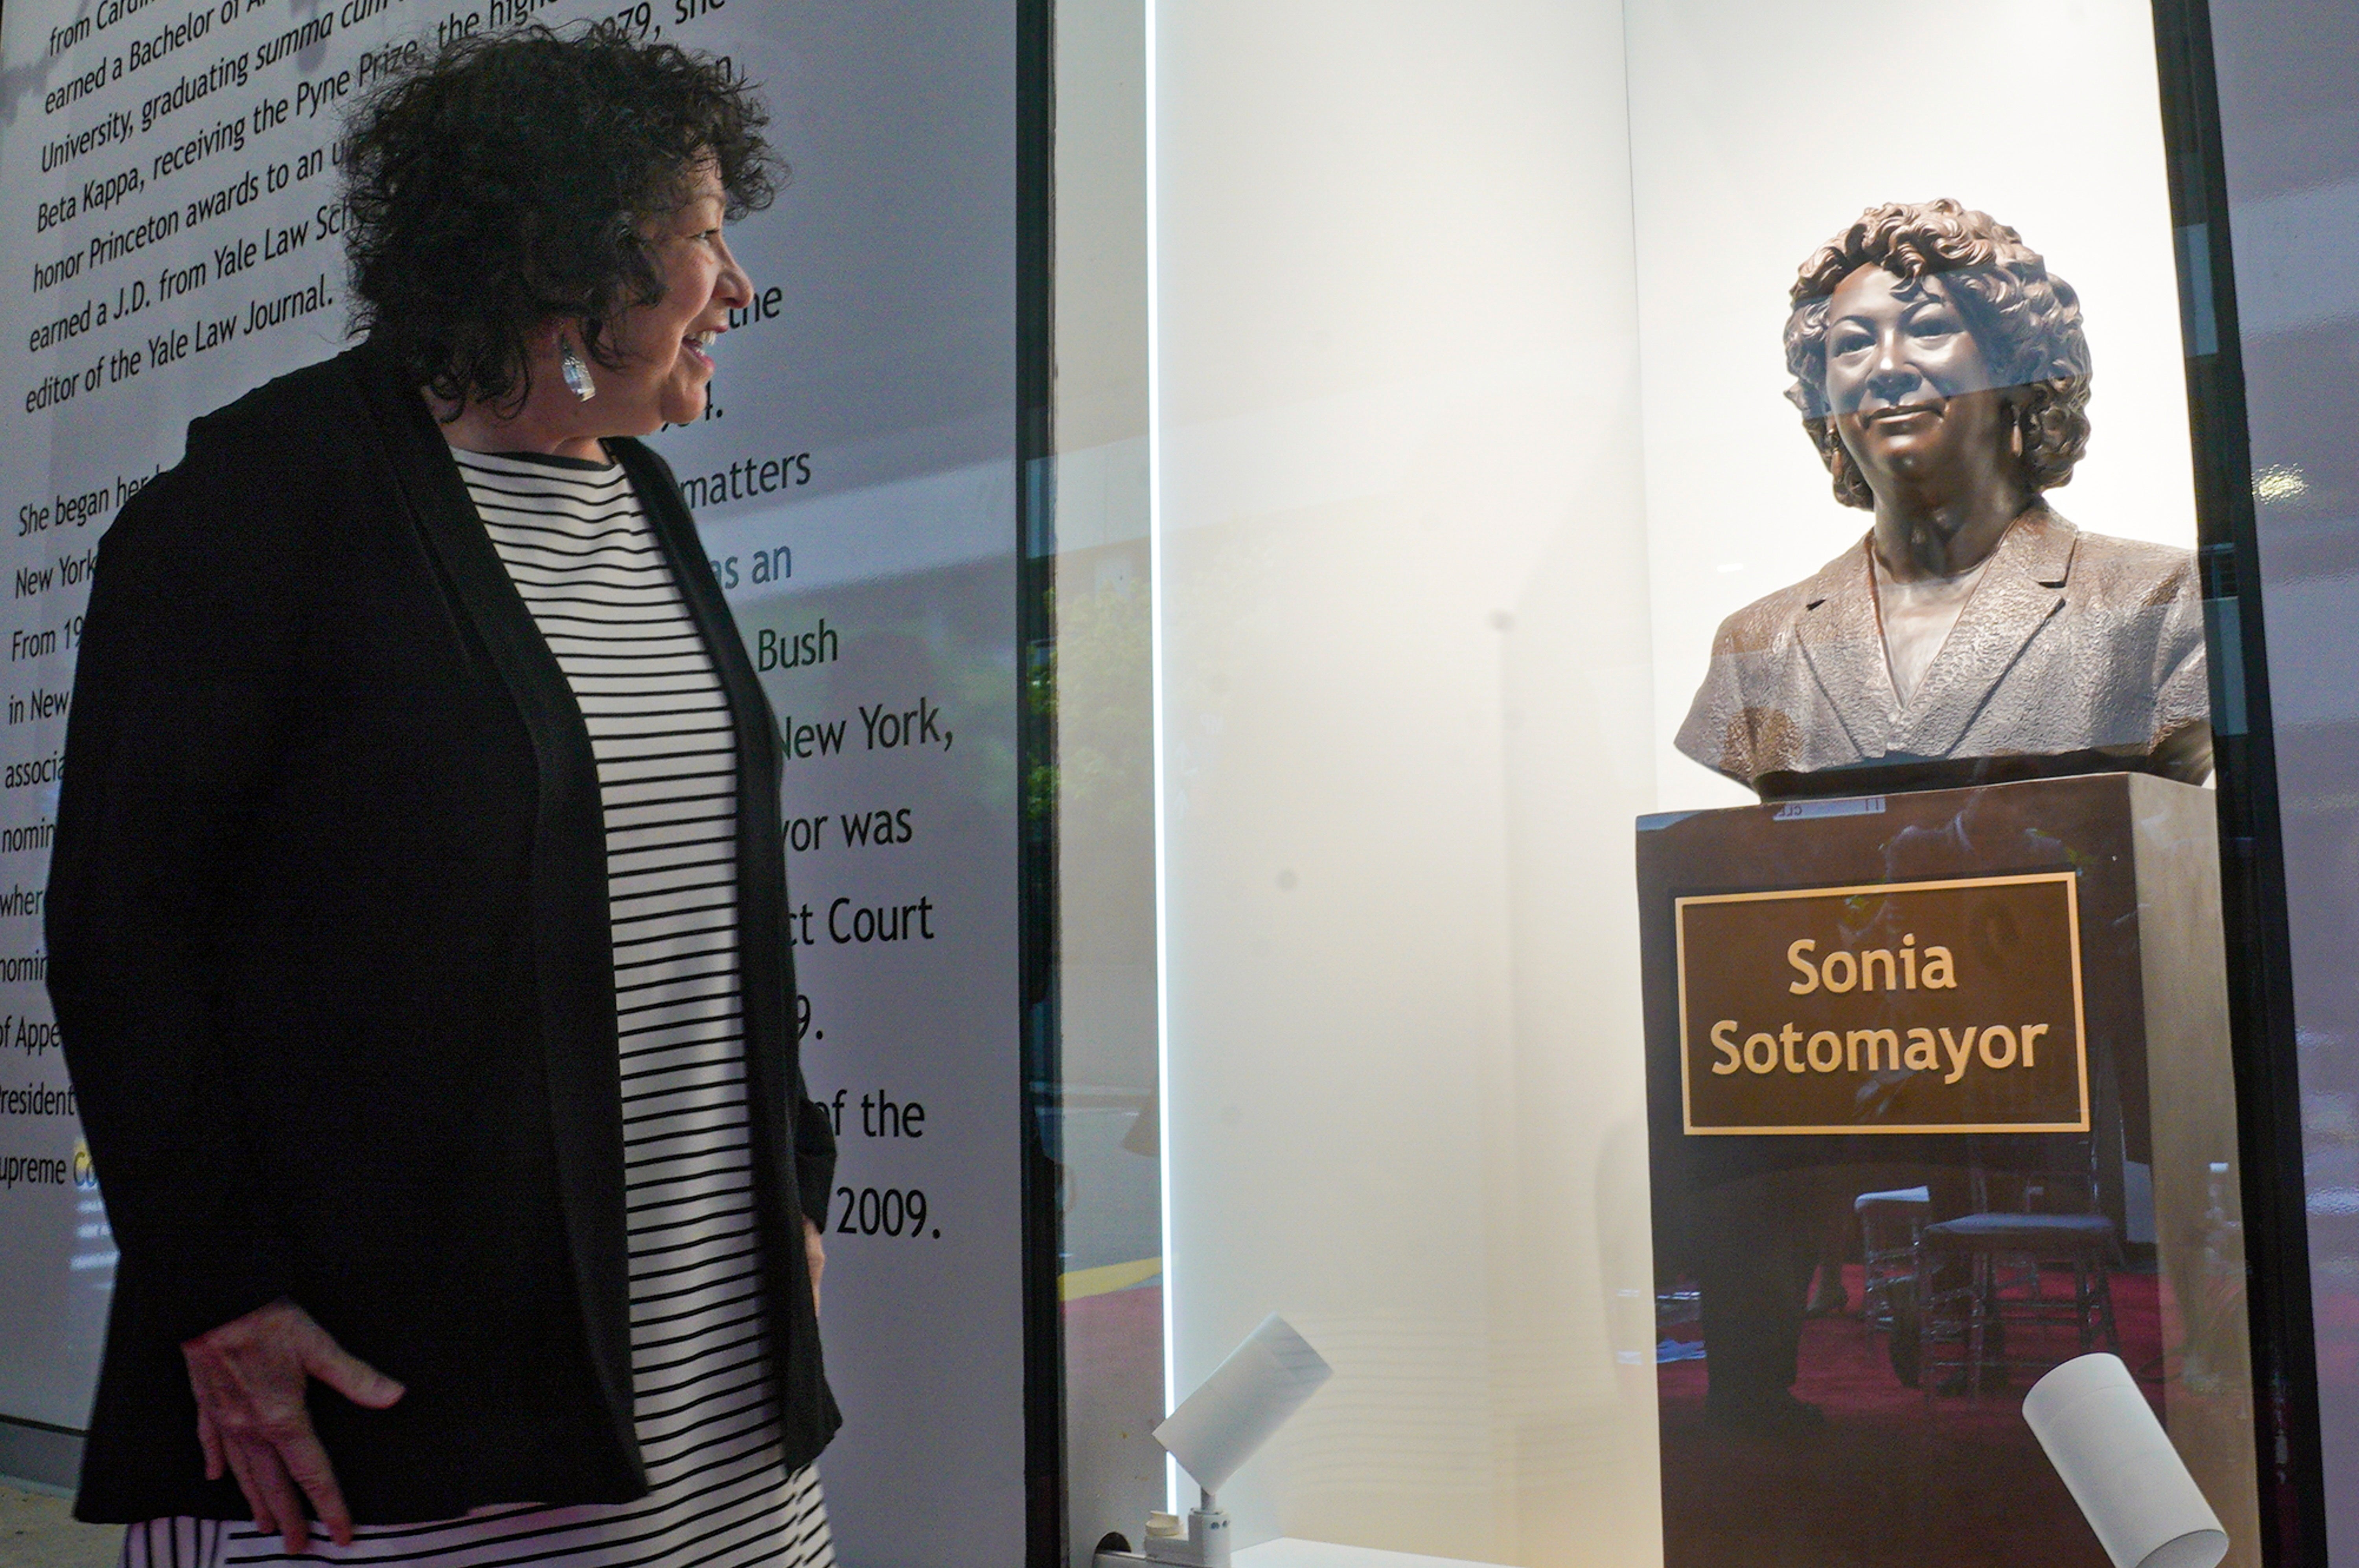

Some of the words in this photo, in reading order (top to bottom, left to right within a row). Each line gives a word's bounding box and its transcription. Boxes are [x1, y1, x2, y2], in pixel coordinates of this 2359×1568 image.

[45, 58, 106, 114] earned
[113, 57, 122, 79] a
[130, 9, 215, 71] Bachelor
[50, 17, 90, 56] from
[37, 190, 75, 233] Beta
[83, 167, 144, 213] Kappa,
[154, 115, 245, 180] receiving
[253, 97, 288, 134] the
[296, 70, 350, 118] Pyne
[438, 13, 479, 50] the
[41, 110, 134, 173] University,
[141, 53, 248, 131] graduating
[255, 11, 334, 70] summa
[34, 251, 83, 292] honor
[90, 210, 178, 269] Princeton
[186, 171, 258, 227] awards
[267, 164, 288, 194] to
[296, 149, 322, 181] an
[29, 301, 90, 352] earned
[97, 303, 107, 325] a
[113, 280, 150, 320] J.D.
[160, 263, 205, 302] from
[214, 239, 256, 279] Yale
[265, 221, 308, 259] Law
[26, 371, 79, 414] editor
[85, 356, 105, 392] of
[110, 344, 140, 383] the
[149, 329, 188, 369] Yale
[196, 316, 237, 353] Law
[244, 274, 333, 335] Journal.
[19, 503, 49, 537] She
[55, 489, 109, 526] began
[117, 476, 148, 507] her
[12, 631, 55, 662] From
[679, 452, 811, 509] matters
[16, 567, 53, 599] New
[59, 549, 98, 587] York
[9, 695, 24, 725] in
[31, 688, 69, 721] New
[751, 546, 791, 585] an
[758, 618, 838, 672] Bush
[859, 697, 953, 752] York,
[841, 808, 913, 848] was
[828, 896, 935, 944] Court
[1787, 933, 1957, 995] Sonia
[1710, 1019, 2049, 1085] Sotomayor
[0, 1081, 75, 1115] resident
[861, 1089, 925, 1138] the
[836, 1187, 940, 1239] 2009.
